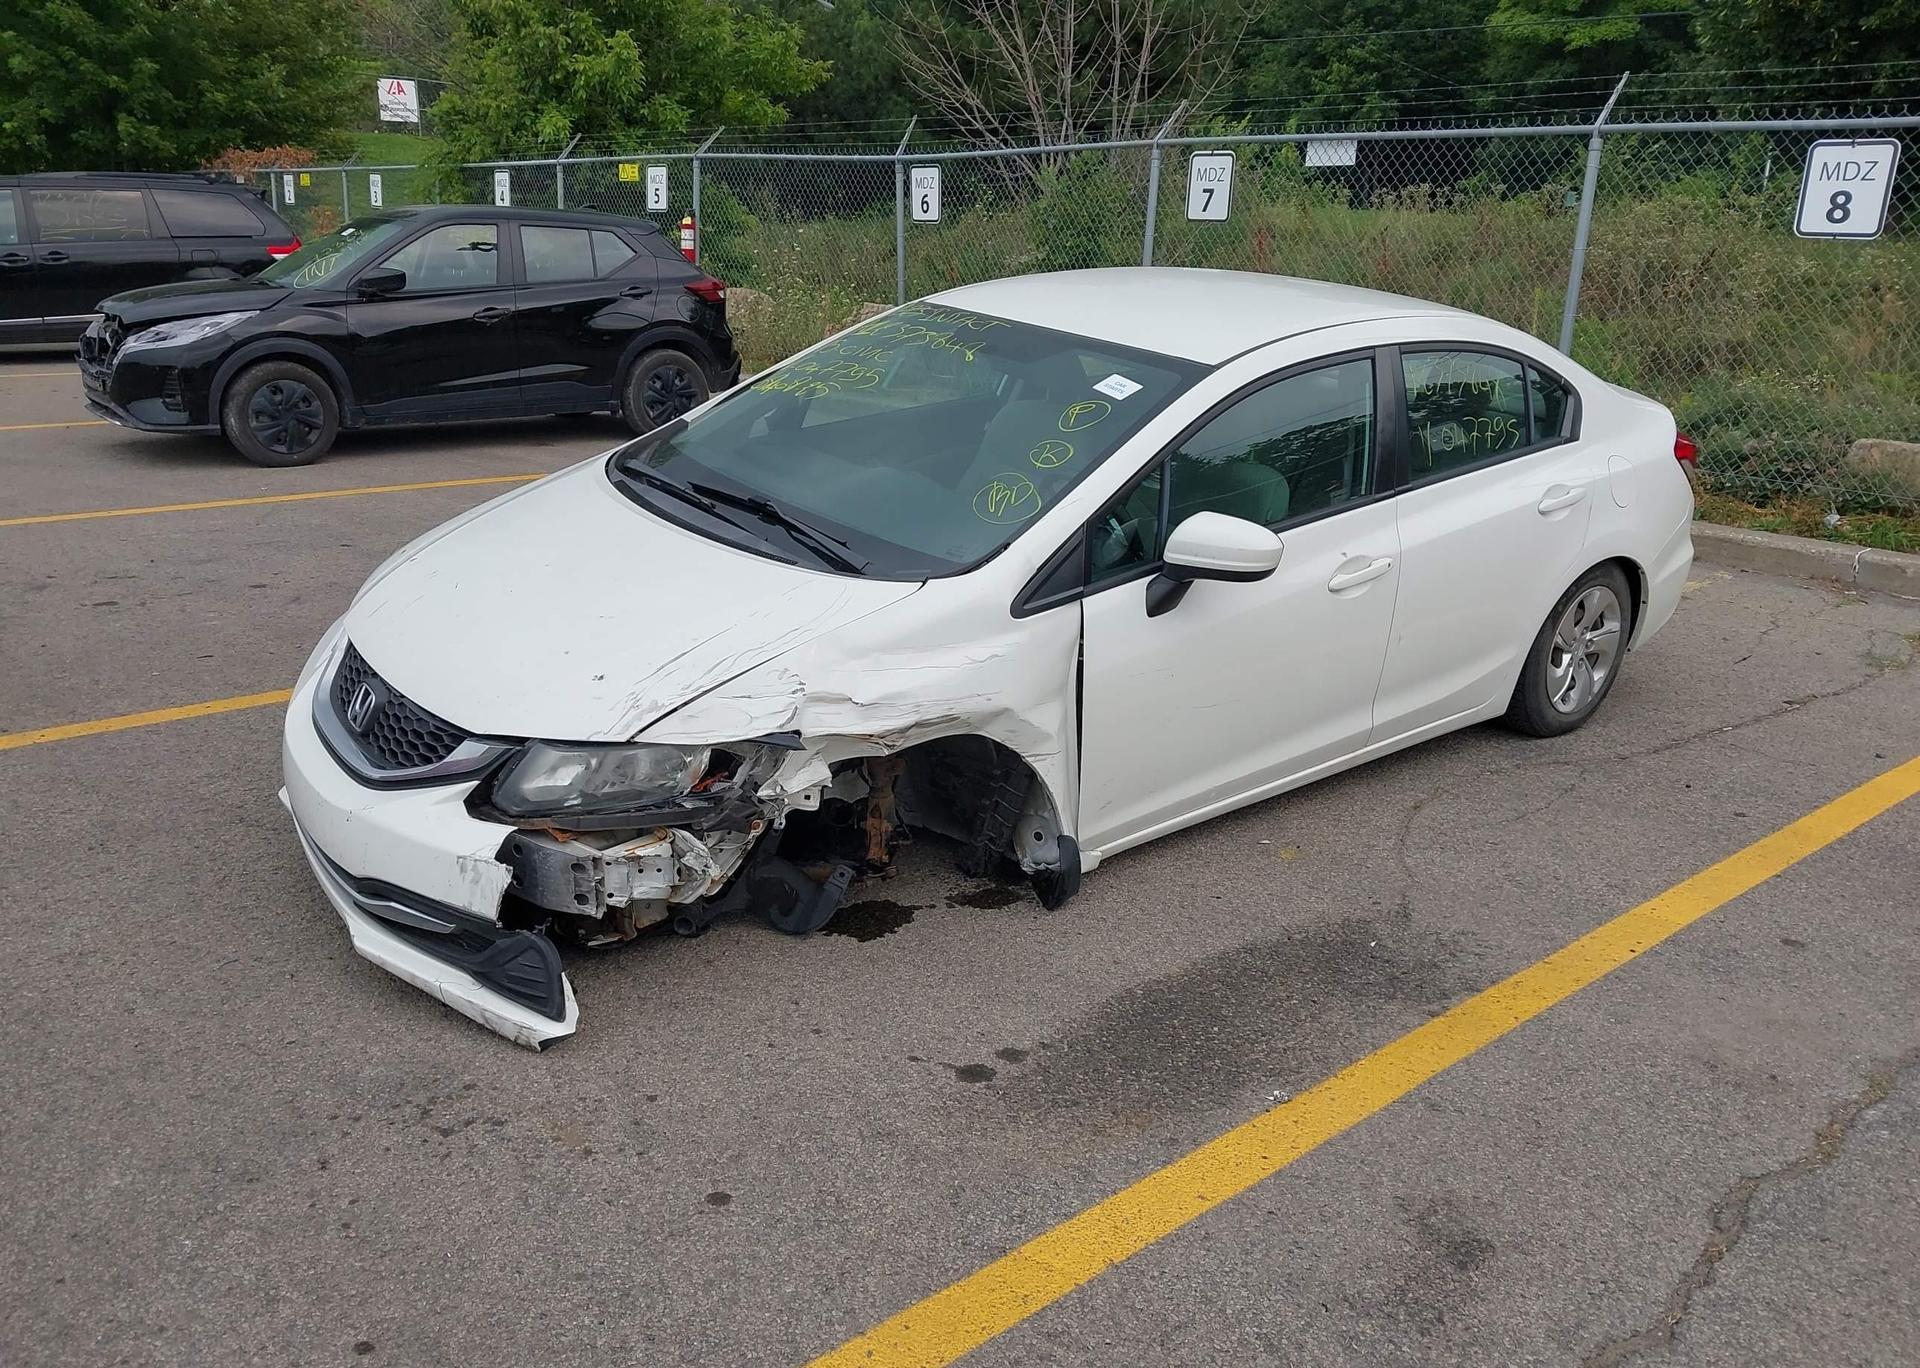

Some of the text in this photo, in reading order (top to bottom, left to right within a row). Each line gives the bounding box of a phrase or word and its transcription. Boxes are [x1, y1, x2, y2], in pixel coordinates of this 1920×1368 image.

[1196, 167, 1226, 183] MDZ
[1818, 160, 1879, 182] MDZ
[650, 174, 664, 185] MDZ
[915, 176, 935, 190] MDZ
[373, 190, 378, 203] 3
[499, 189, 505, 205] 4
[653, 187, 660, 204] 5
[921, 193, 930, 214] 6
[1201, 188, 1215, 213] 7
[1825, 190, 1853, 224] 8
